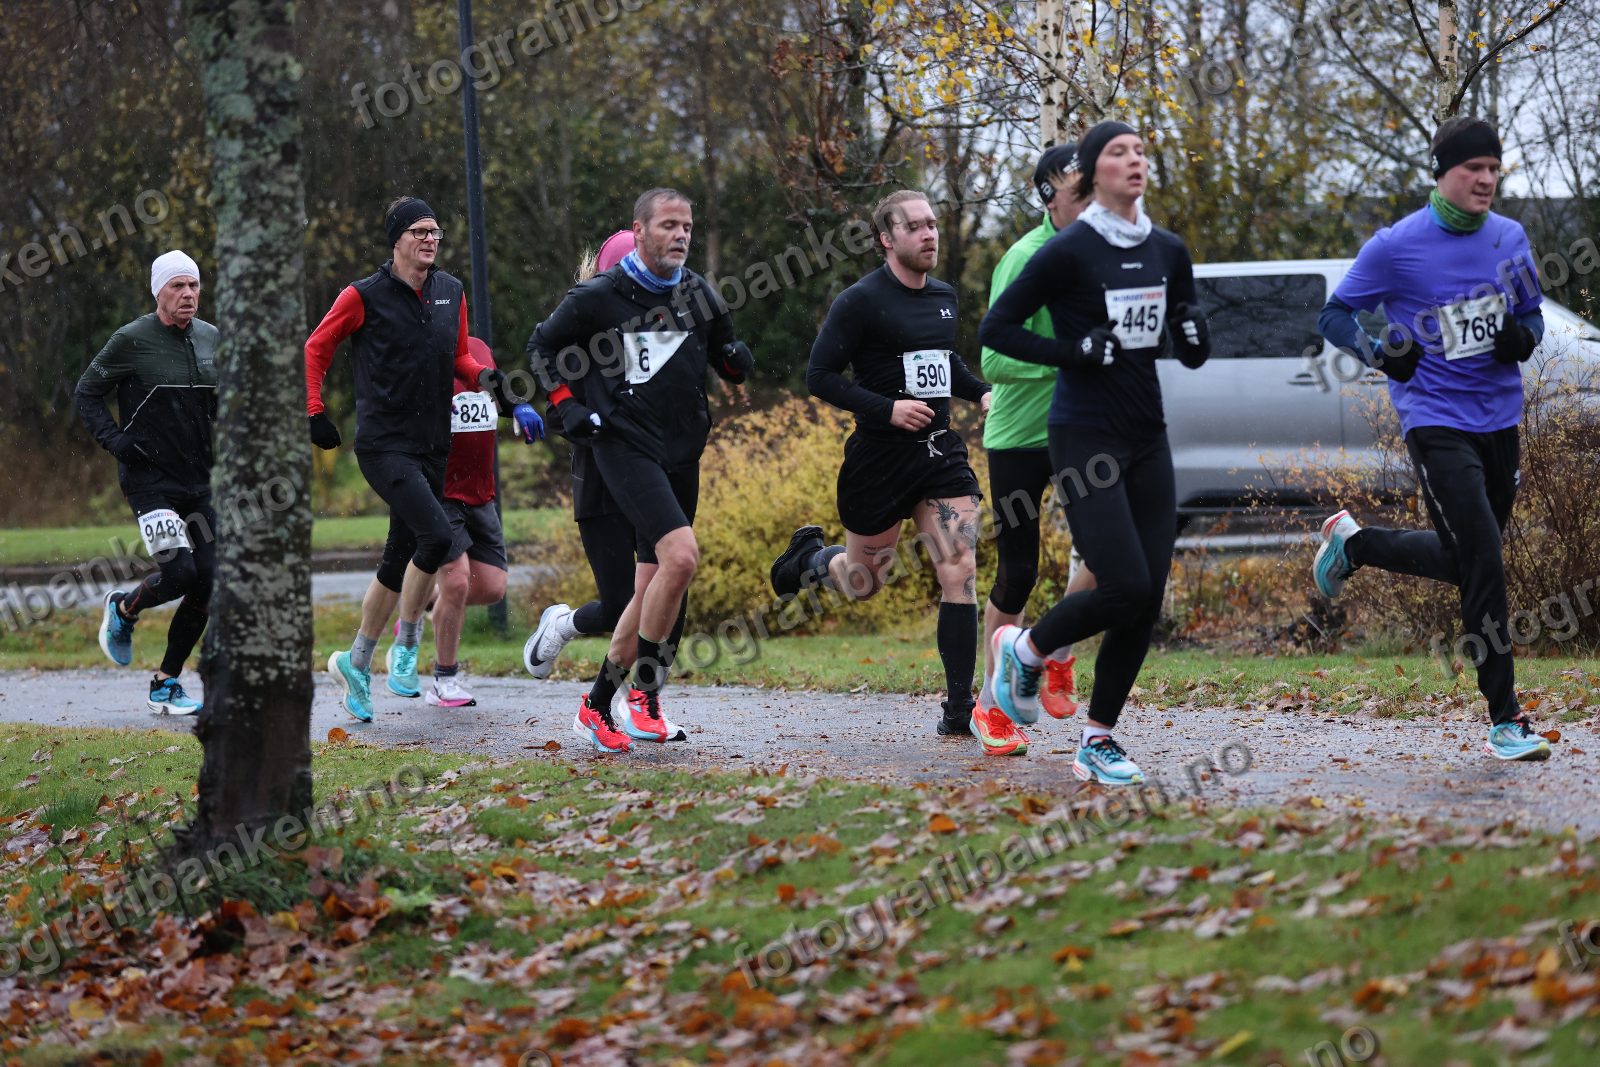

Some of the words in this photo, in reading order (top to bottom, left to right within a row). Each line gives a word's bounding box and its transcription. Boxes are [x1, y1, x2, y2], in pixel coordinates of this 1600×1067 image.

[1122, 305, 1159, 334] 445
[1455, 313, 1498, 345] 768
[917, 363, 947, 388] 590
[460, 403, 490, 423] 824
[145, 519, 184, 543] 9482
